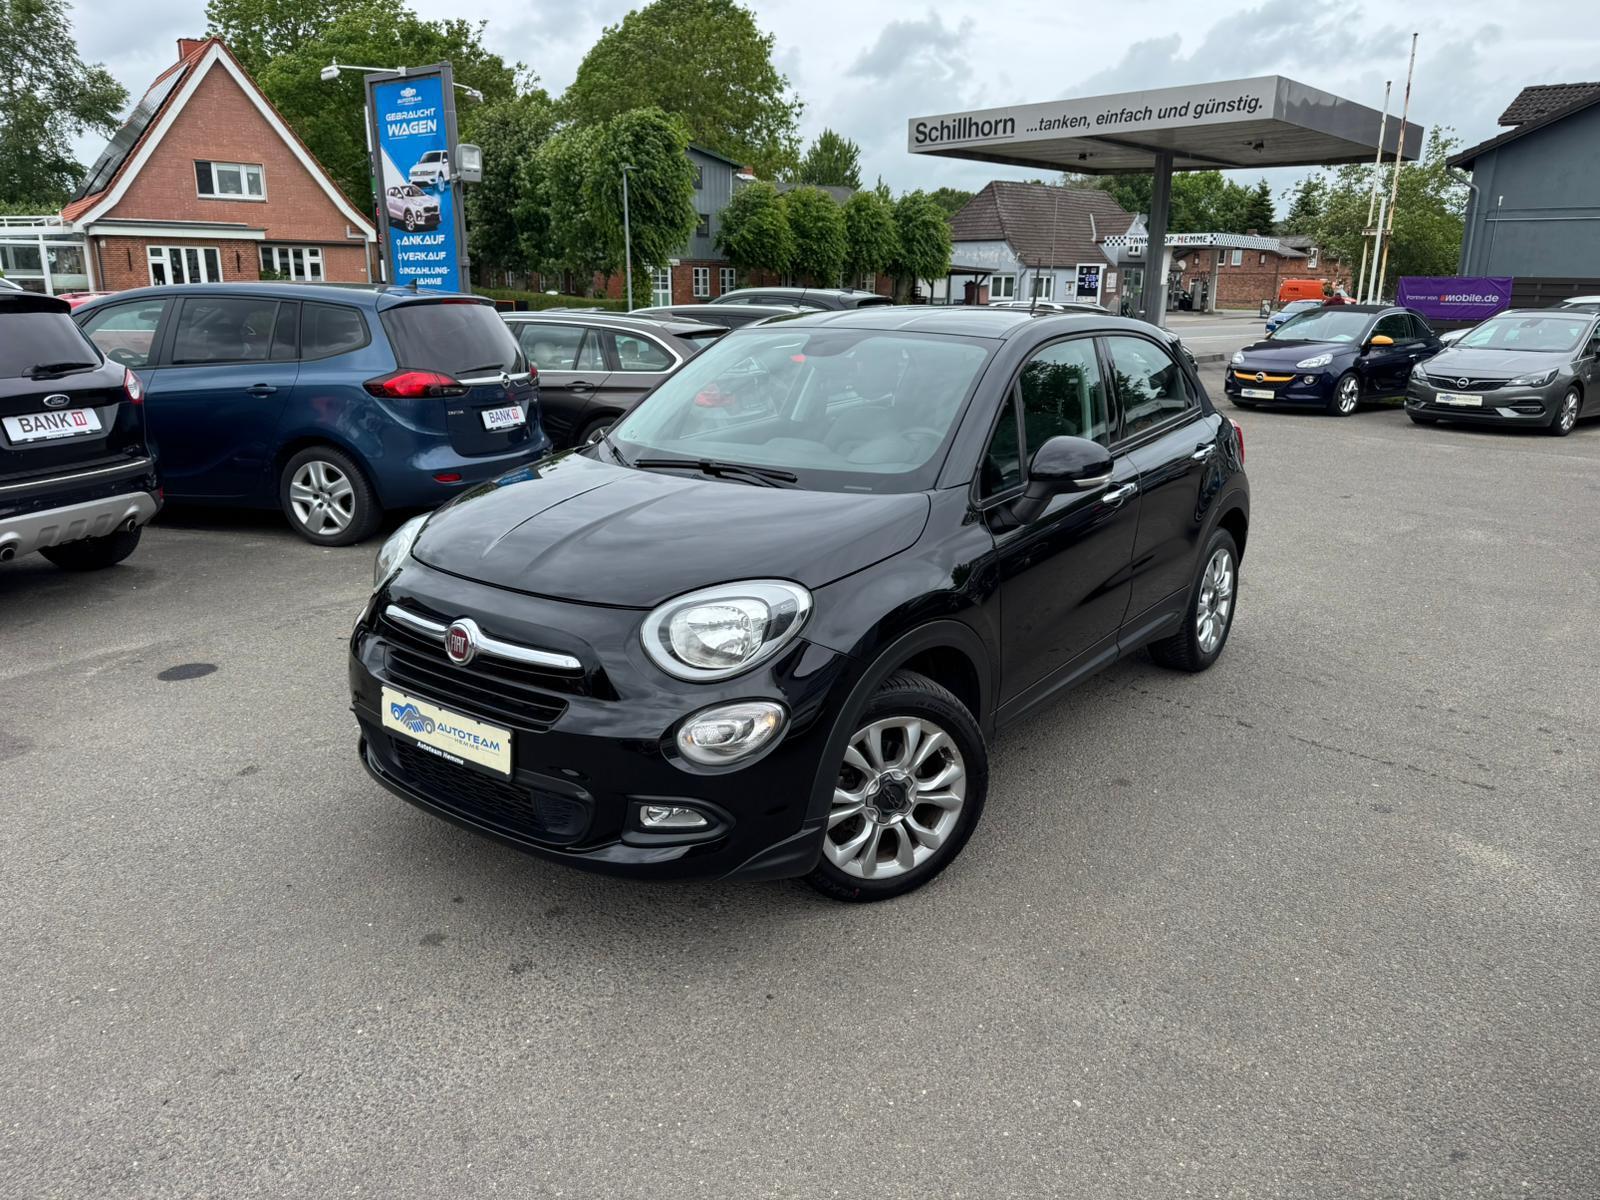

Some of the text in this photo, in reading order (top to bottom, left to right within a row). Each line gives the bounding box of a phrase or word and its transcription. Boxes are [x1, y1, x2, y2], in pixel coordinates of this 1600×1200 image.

[385, 107, 436, 122] GEBRAUCHT
[915, 95, 1263, 144] Schillhorn ...tanken, einfach und günstig.
[387, 119, 437, 137] WAGEN
[401, 234, 446, 246] ANKAUF
[402, 251, 447, 261] VERKAUF
[403, 266, 450, 275] INZAHLUNG-
[1444, 294, 1499, 303] mobile.de
[18, 412, 72, 433] BANK
[488, 408, 513, 424] BANK
[451, 634, 466, 654] FIAT
[437, 722, 500, 752] AUTOTEAM
[454, 738, 480, 751] HEMME
[416, 742, 464, 766] Autoteam Hemme
